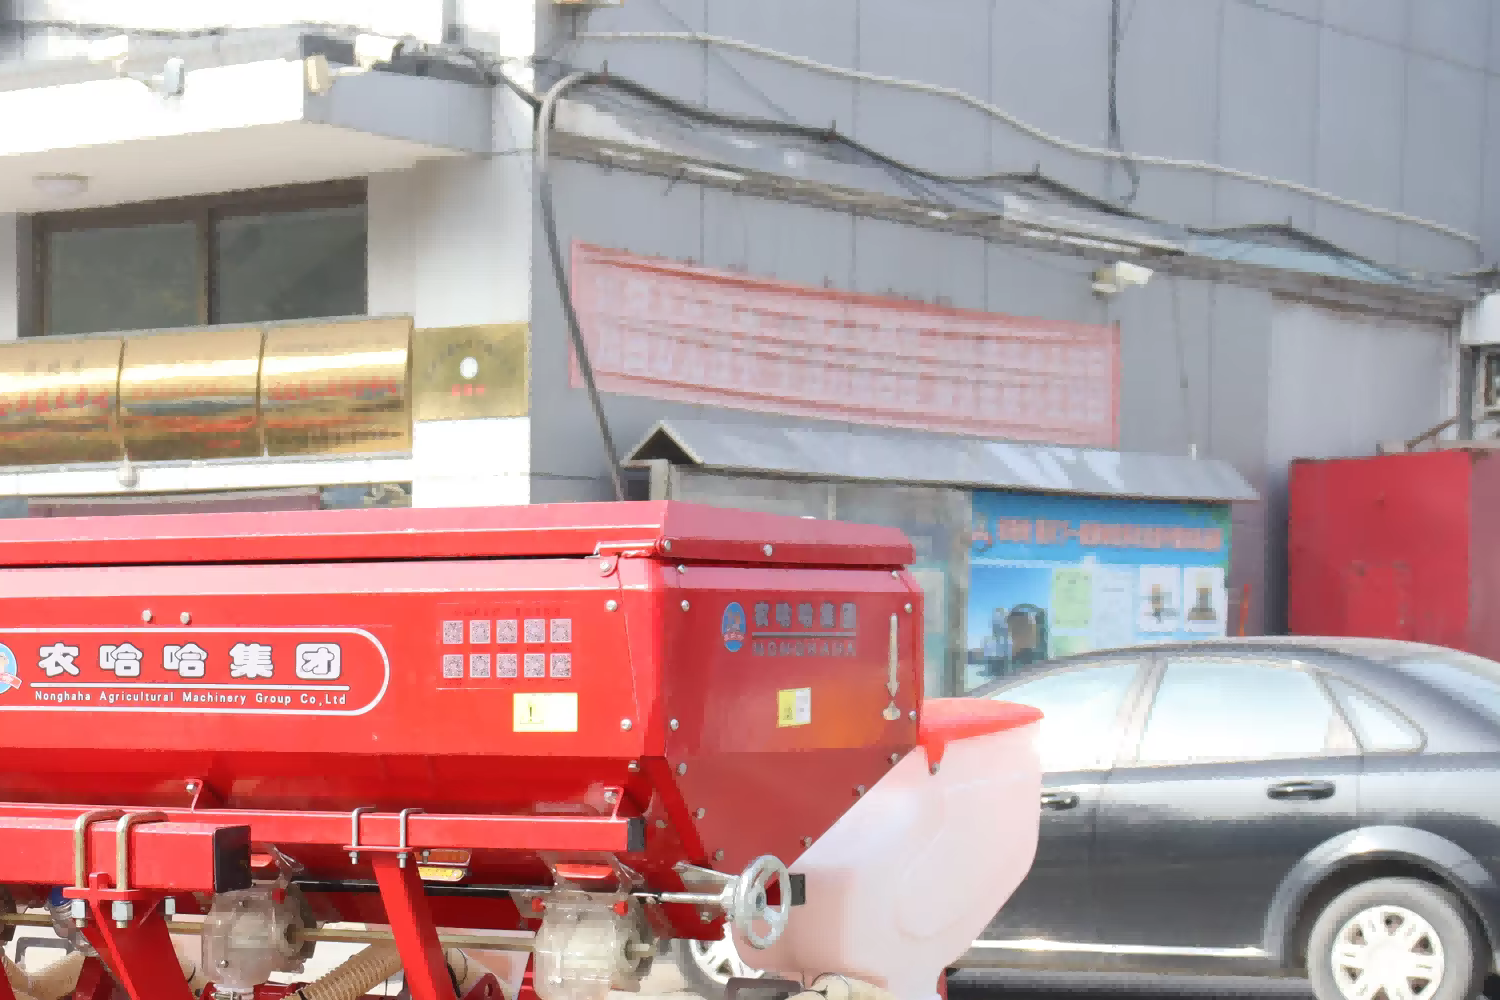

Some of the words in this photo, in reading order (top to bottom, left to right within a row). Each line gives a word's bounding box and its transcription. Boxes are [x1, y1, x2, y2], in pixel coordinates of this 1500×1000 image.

[37, 642, 342, 680] 农哈哈集团
[35, 691, 91, 703] Nonghaha
[99, 691, 175, 704] Agricultural
[182, 692, 247, 705] Machinery
[255, 693, 292, 706] Group
